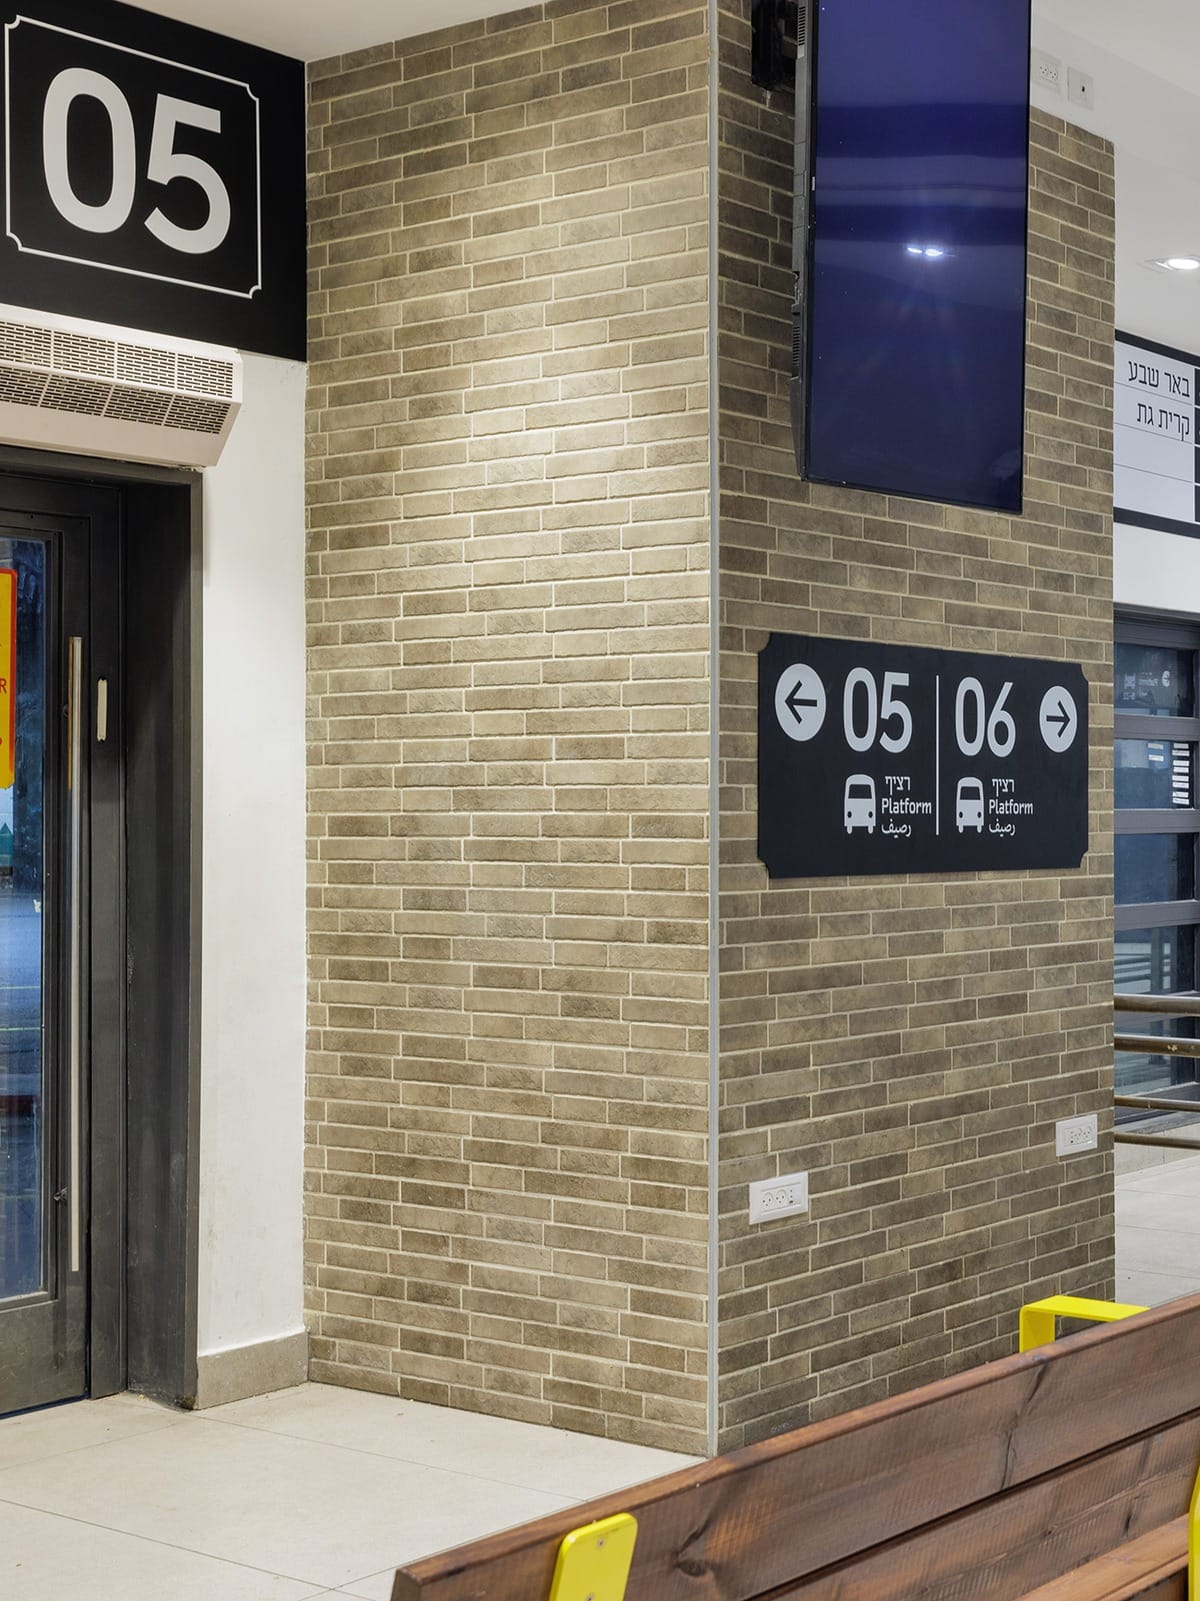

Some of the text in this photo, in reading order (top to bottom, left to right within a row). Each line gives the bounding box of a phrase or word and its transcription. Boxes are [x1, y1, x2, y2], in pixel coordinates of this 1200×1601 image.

[42, 67, 231, 254] 05
[1128, 360, 1190, 398] באר שבע
[1136, 402, 1190, 441] קרית גת
[843, 667, 912, 753] 05
[955, 677, 1016, 757] 06
[885, 776, 911, 796] רציף
[992, 778, 1015, 797] רציף
[881, 797, 932, 815] Platform
[988, 799, 1033, 815] Platform
[881, 819, 912, 838] رصيف
[988, 818, 1016, 837] رصيف
